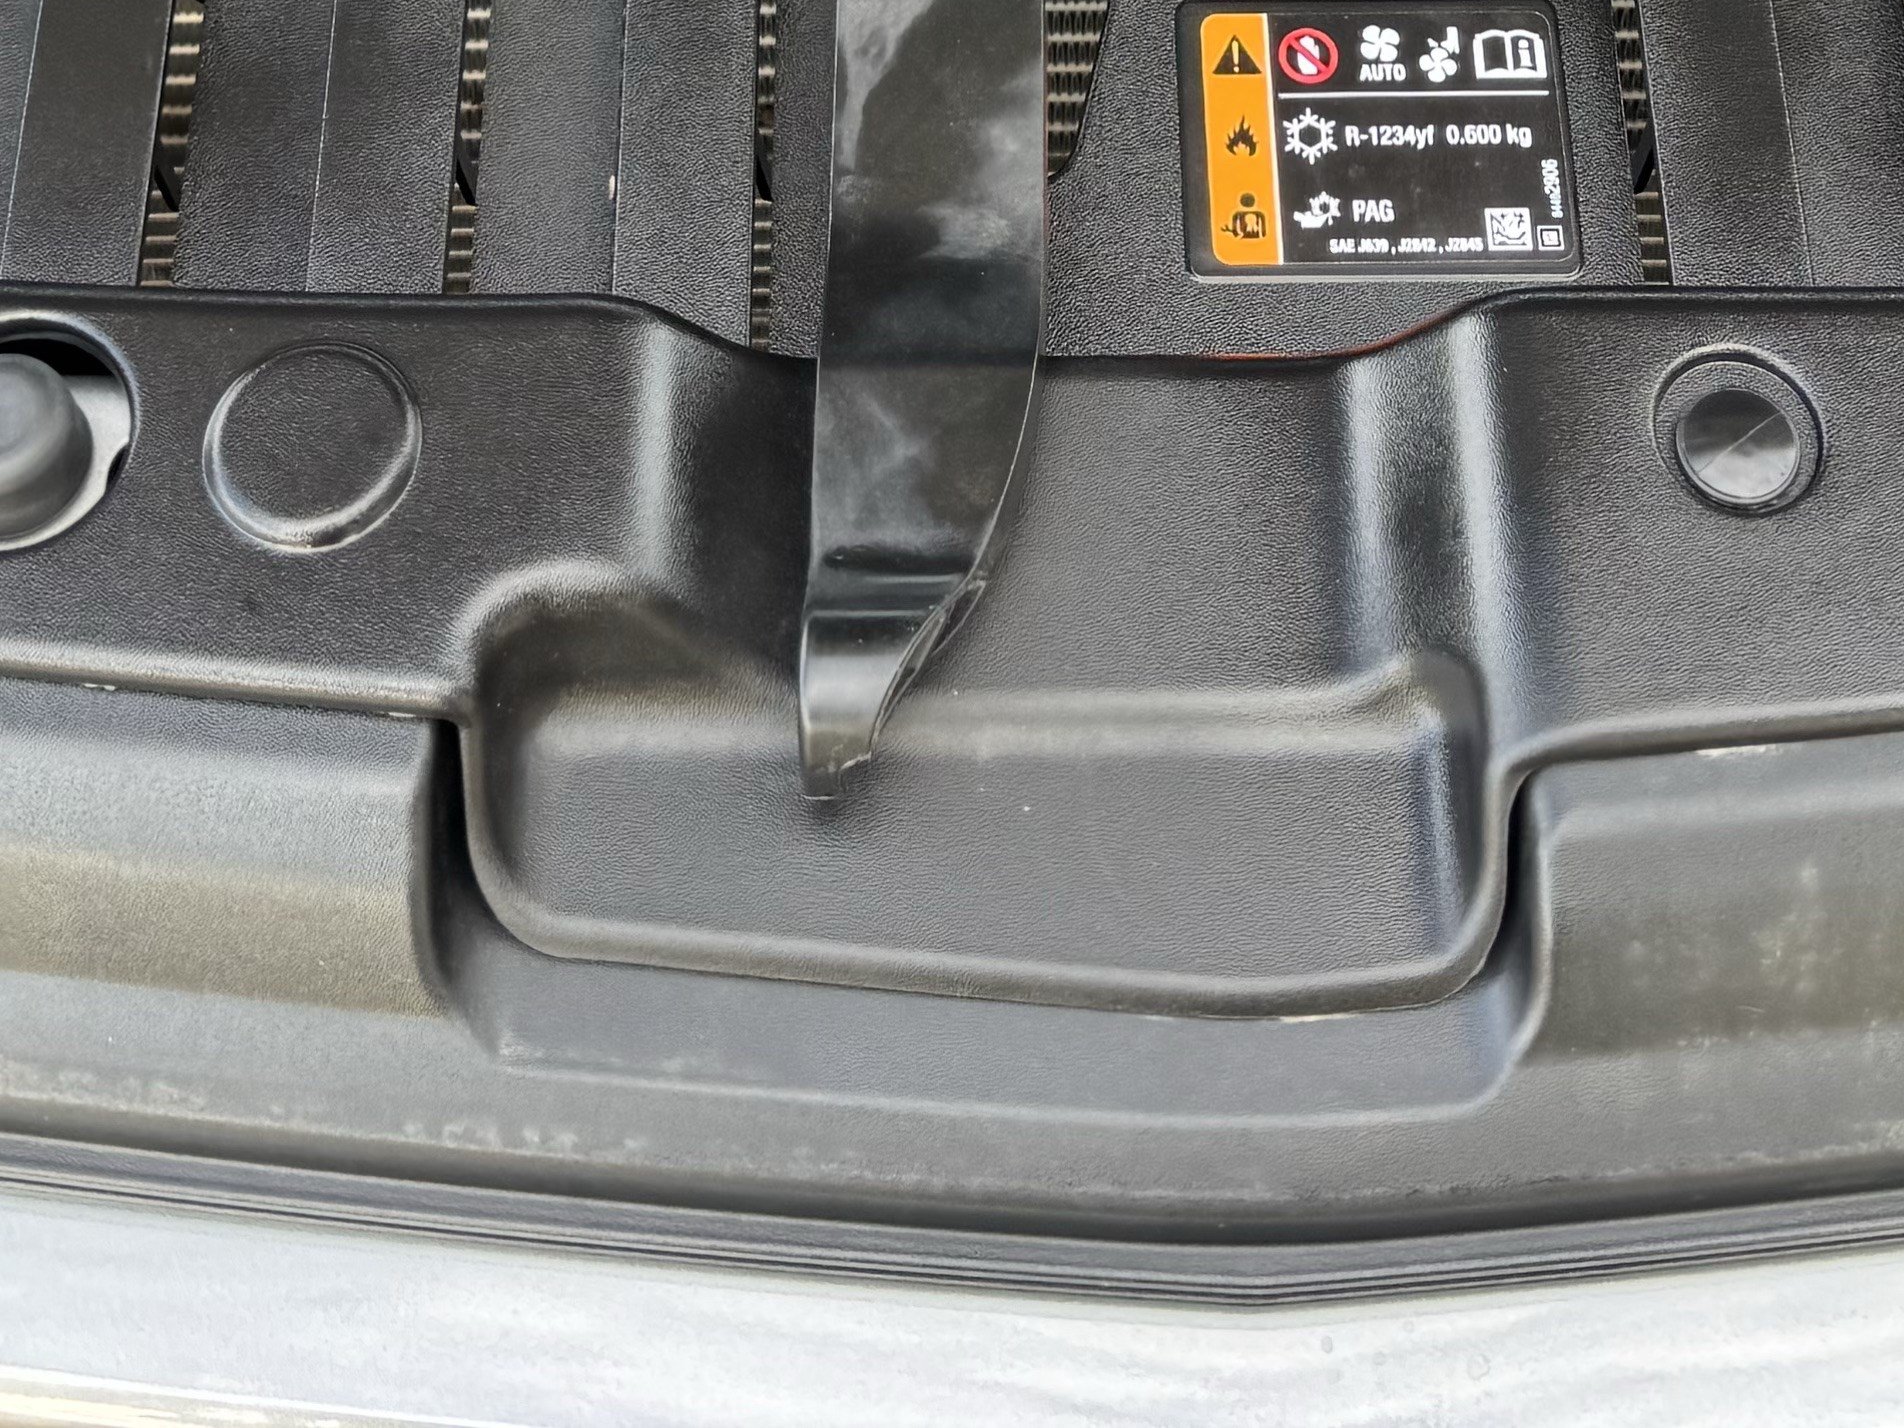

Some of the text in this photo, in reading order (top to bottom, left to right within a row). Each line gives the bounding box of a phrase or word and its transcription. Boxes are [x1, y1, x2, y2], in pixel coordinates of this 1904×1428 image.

[1359, 63, 1407, 82] AUTO
[1345, 122, 1533, 150] R-1234yf 0.600 kg
[1352, 199, 1396, 223] PAG
[1329, 238, 1355, 254] SAE
